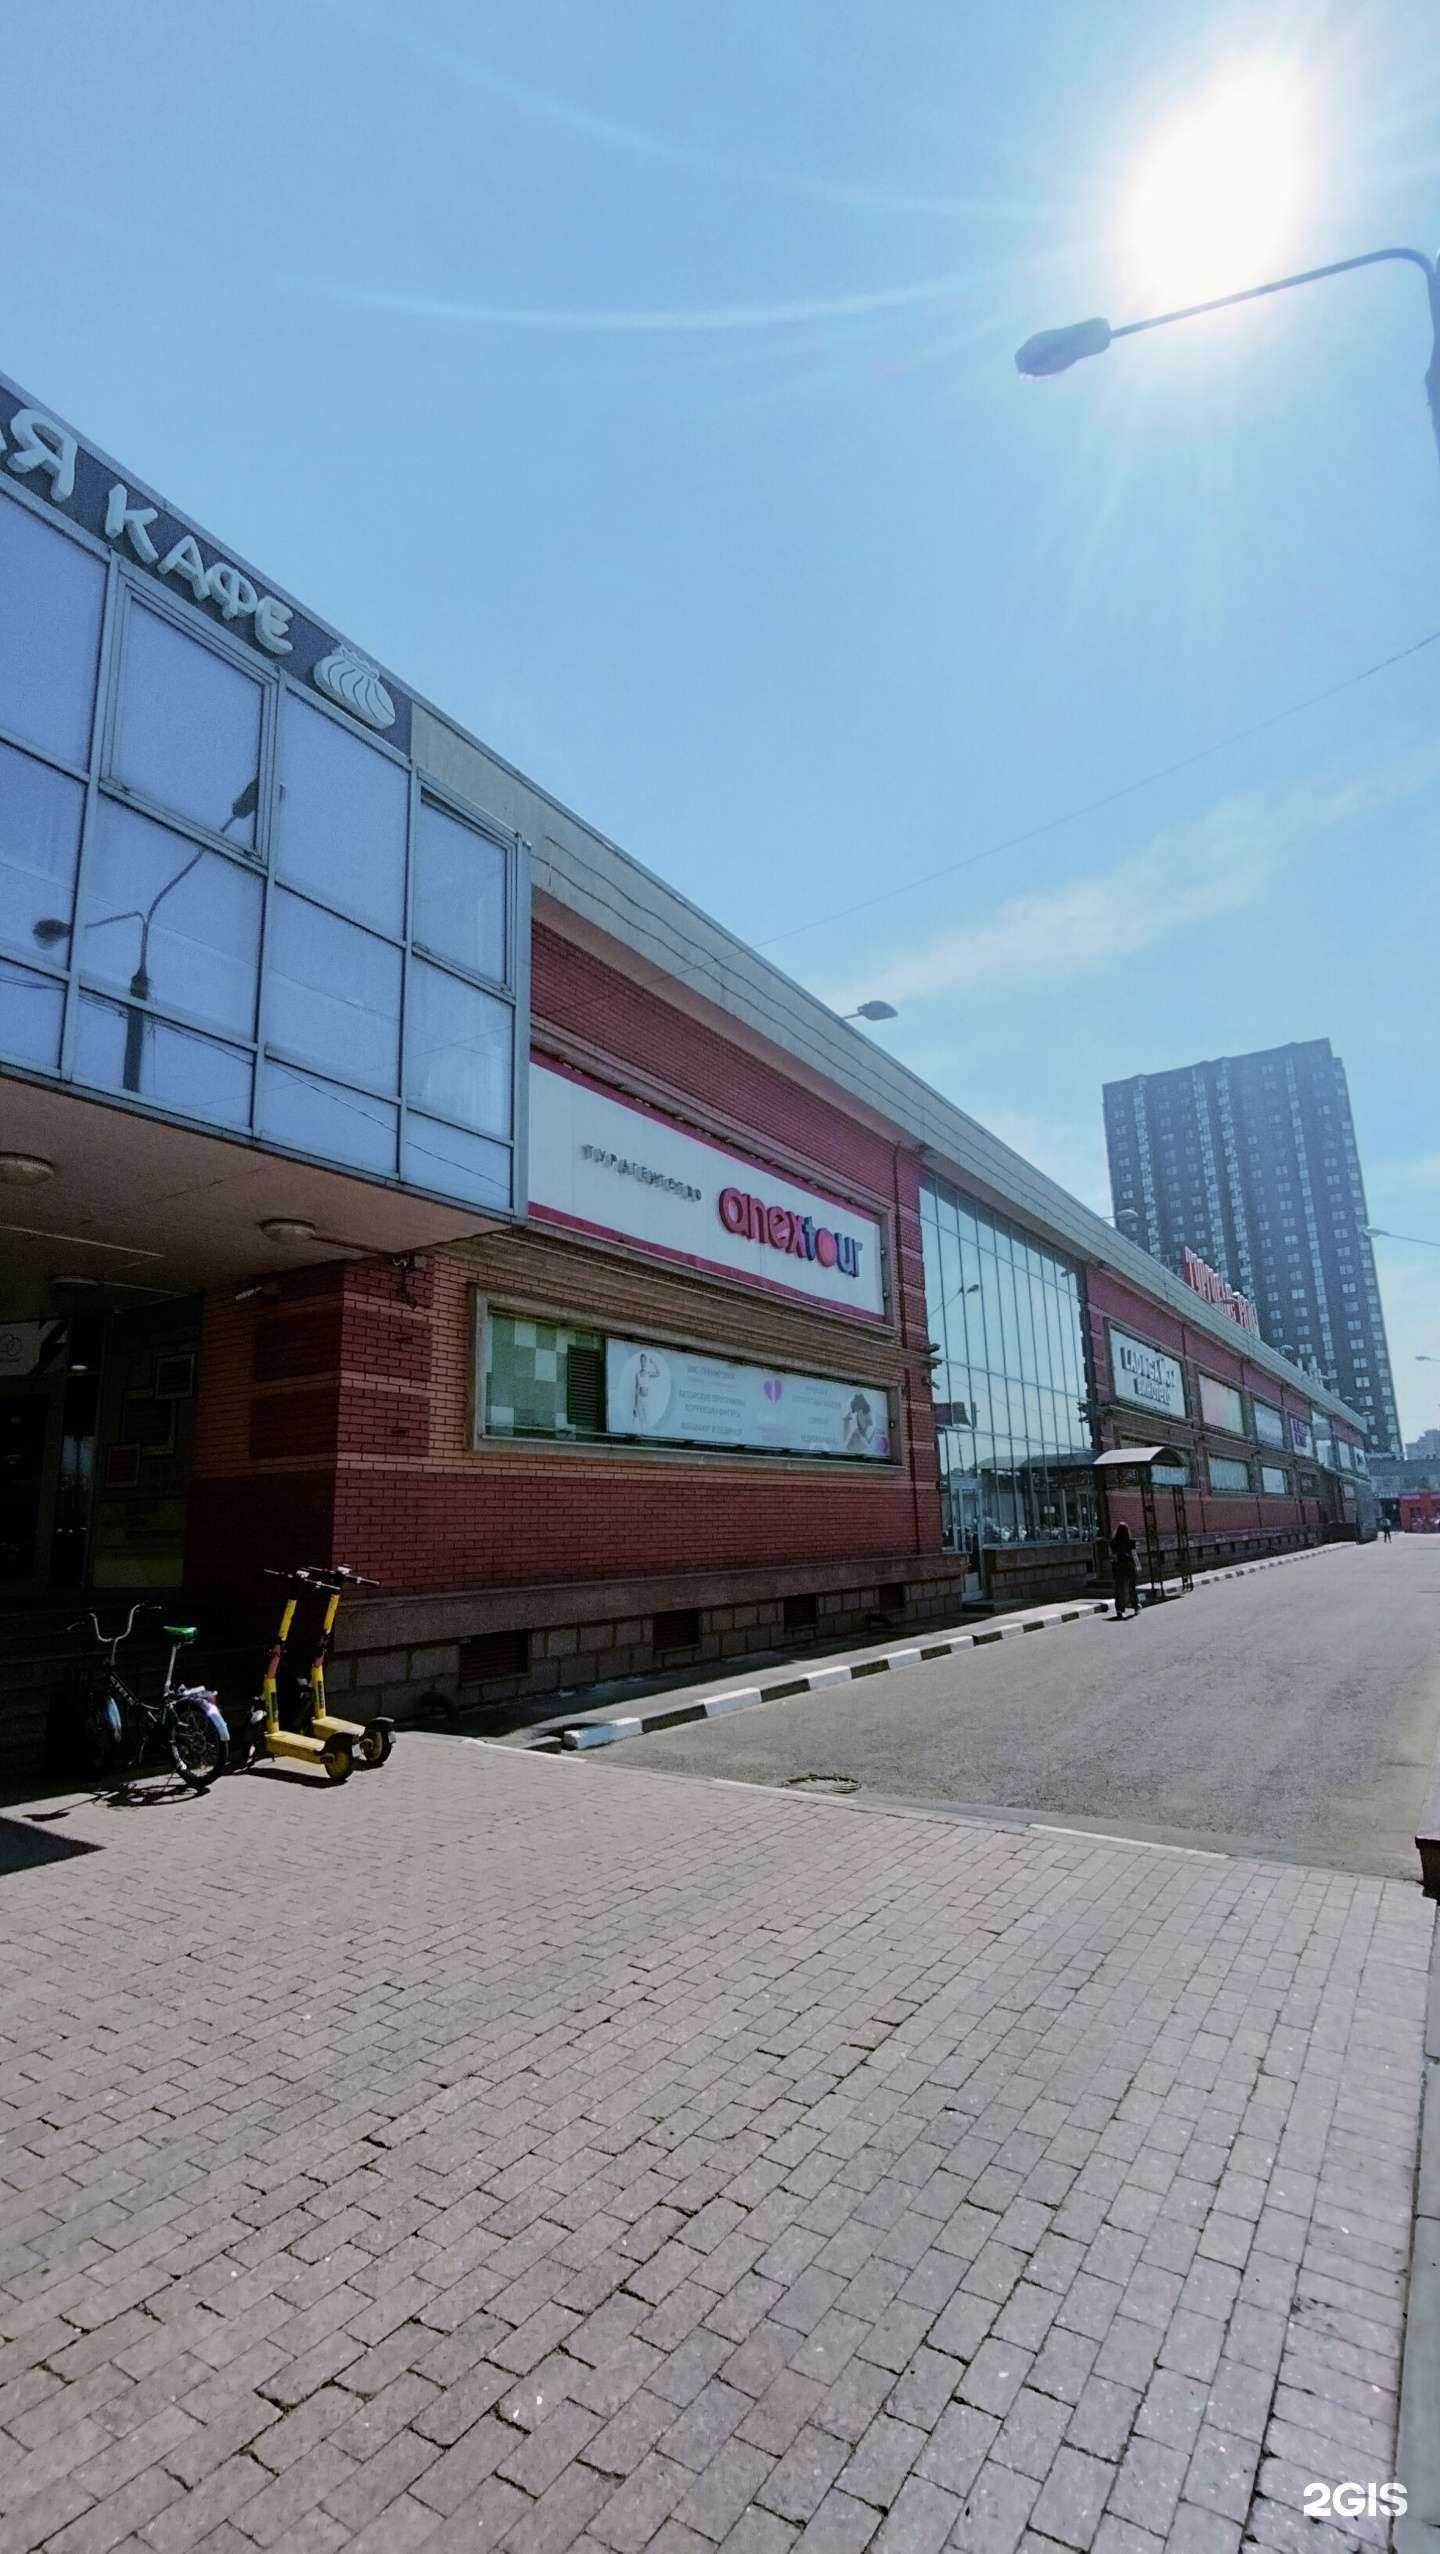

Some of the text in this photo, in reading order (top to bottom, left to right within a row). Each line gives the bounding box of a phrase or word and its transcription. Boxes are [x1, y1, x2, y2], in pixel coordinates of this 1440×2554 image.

[0, 409, 293, 656] Я КАФЕ
[719, 1187, 863, 1277] anextour
